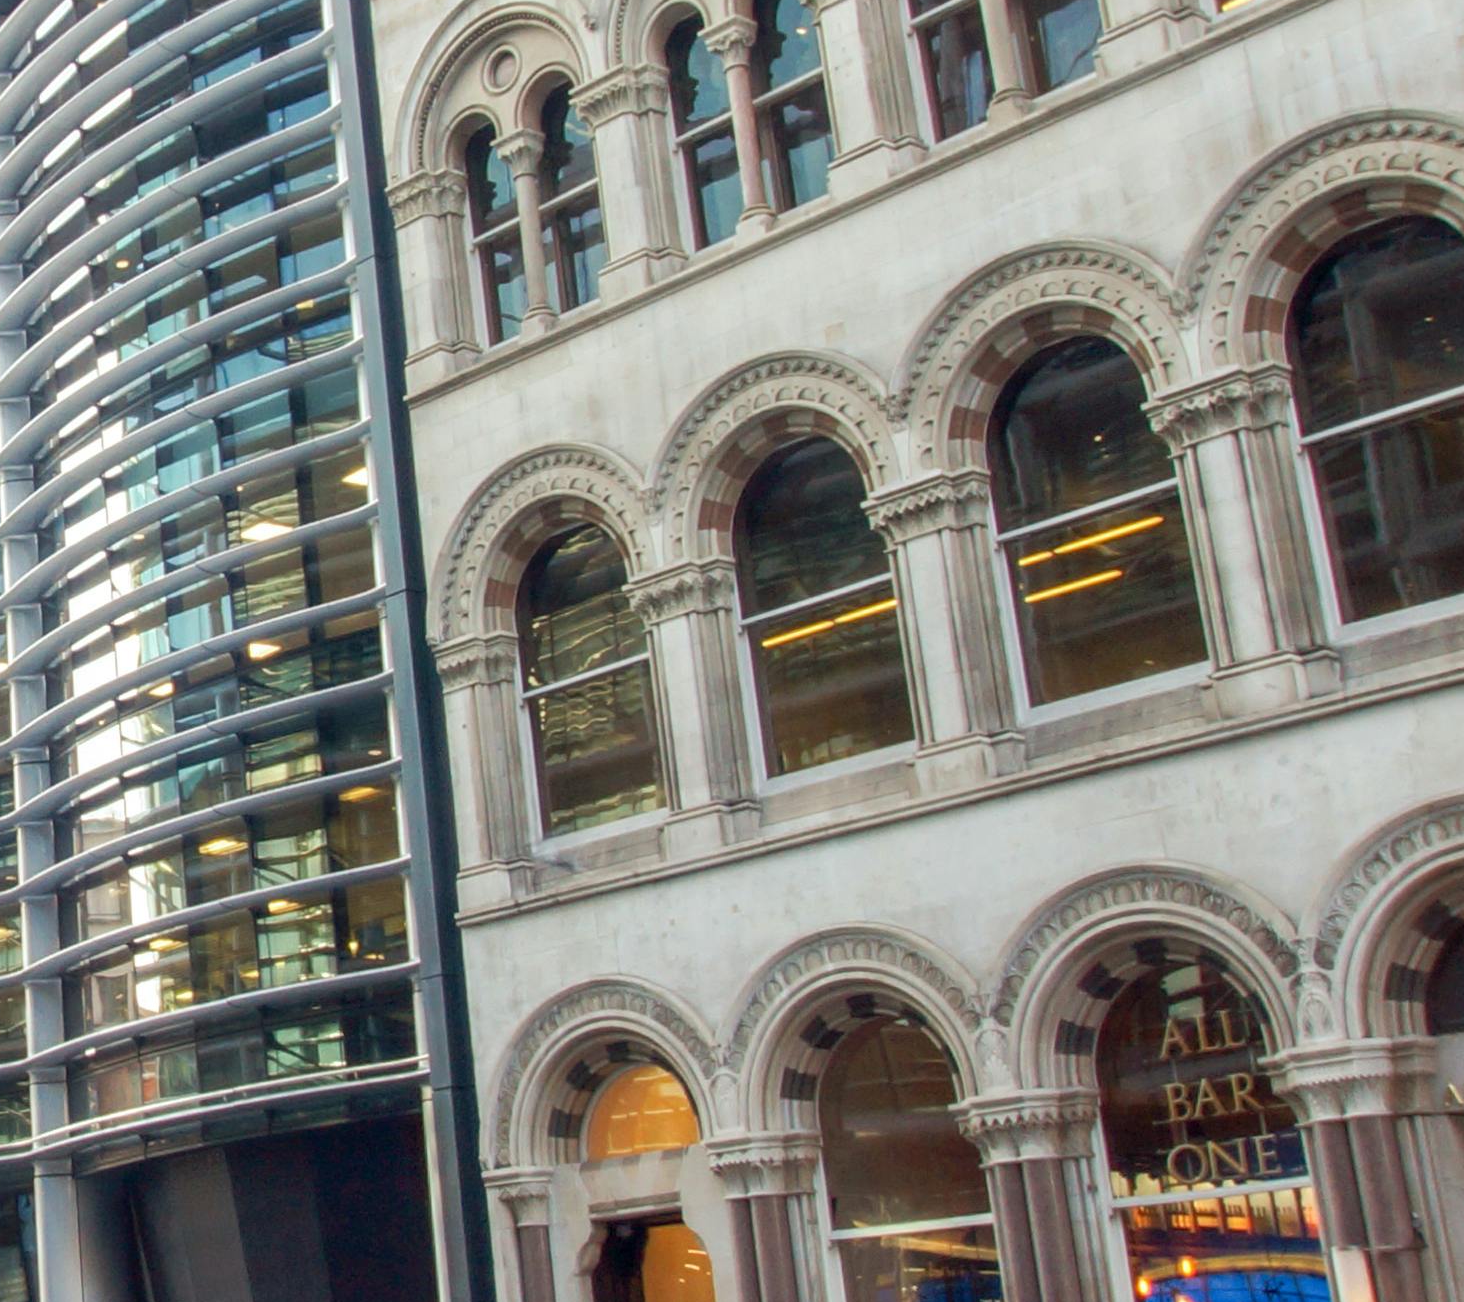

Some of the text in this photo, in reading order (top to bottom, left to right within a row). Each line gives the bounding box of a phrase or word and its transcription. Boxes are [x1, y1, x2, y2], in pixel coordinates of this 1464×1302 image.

[1158, 1009, 1249, 1060] ALL
[1162, 1072, 1266, 1123] BAR
[1167, 1133, 1283, 1184] ONE
